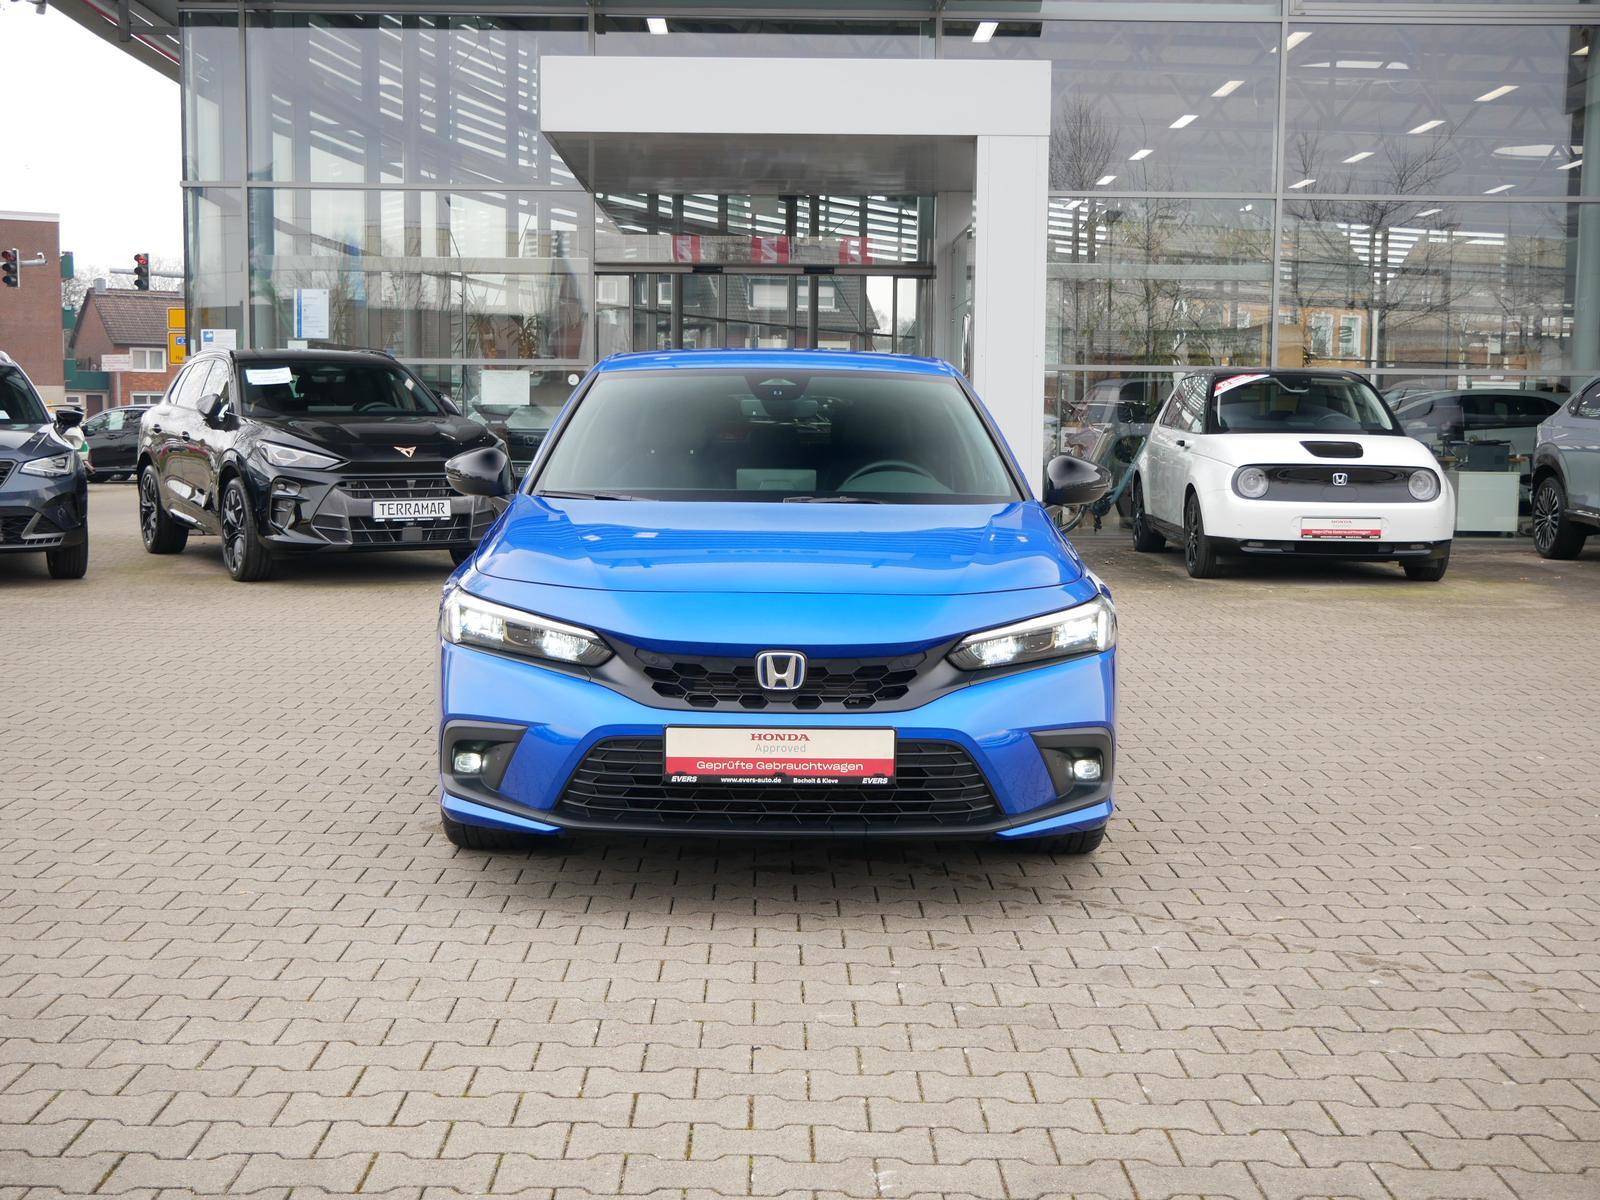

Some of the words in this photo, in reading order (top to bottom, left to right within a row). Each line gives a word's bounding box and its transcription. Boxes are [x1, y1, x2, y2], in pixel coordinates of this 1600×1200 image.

[379, 502, 445, 516] TERRAMAR
[751, 733, 811, 742] HONDA
[754, 743, 807, 753] Approved
[696, 760, 754, 771] Geprüfte
[756, 760, 864, 773] Gebrauchtwagen
[671, 775, 698, 783] EVERS
[720, 776, 782, 784] www.evers-auto.de
[862, 777, 888, 785] EVERS
